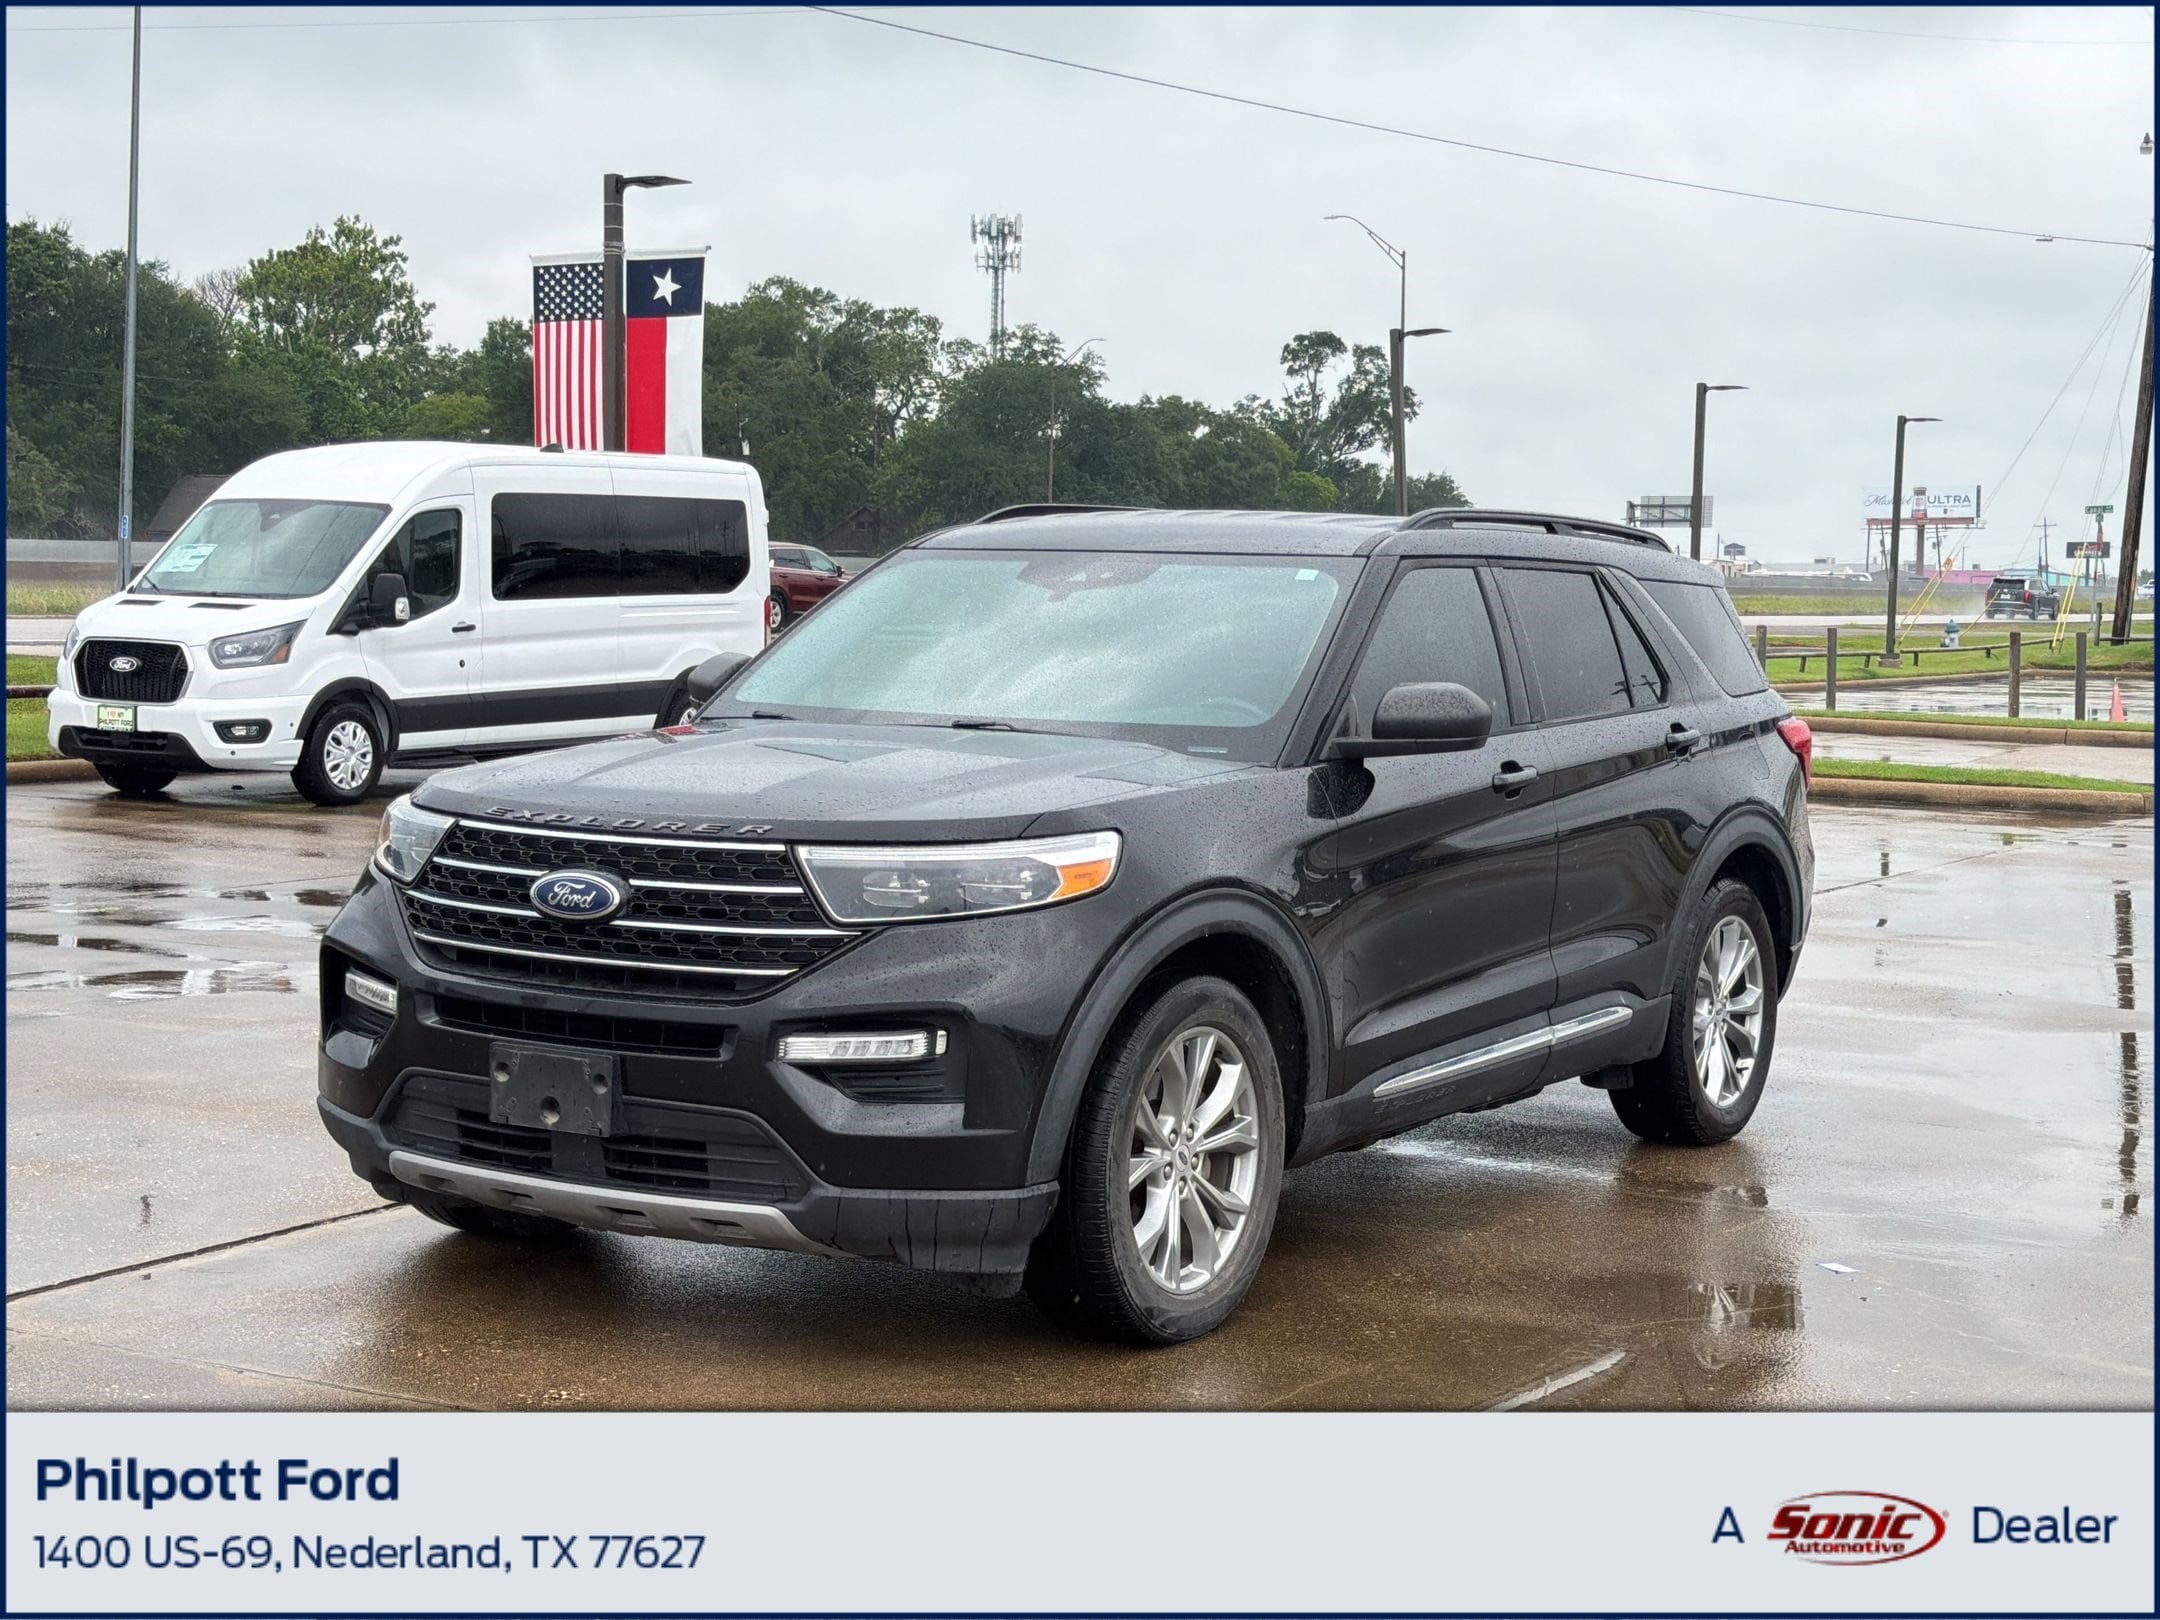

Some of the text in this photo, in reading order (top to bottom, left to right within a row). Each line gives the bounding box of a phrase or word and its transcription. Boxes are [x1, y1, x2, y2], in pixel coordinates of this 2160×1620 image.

[1927, 495, 1971, 504] ULTRA
[485, 806, 773, 835] EXPLORER
[548, 881, 594, 909] Ford
